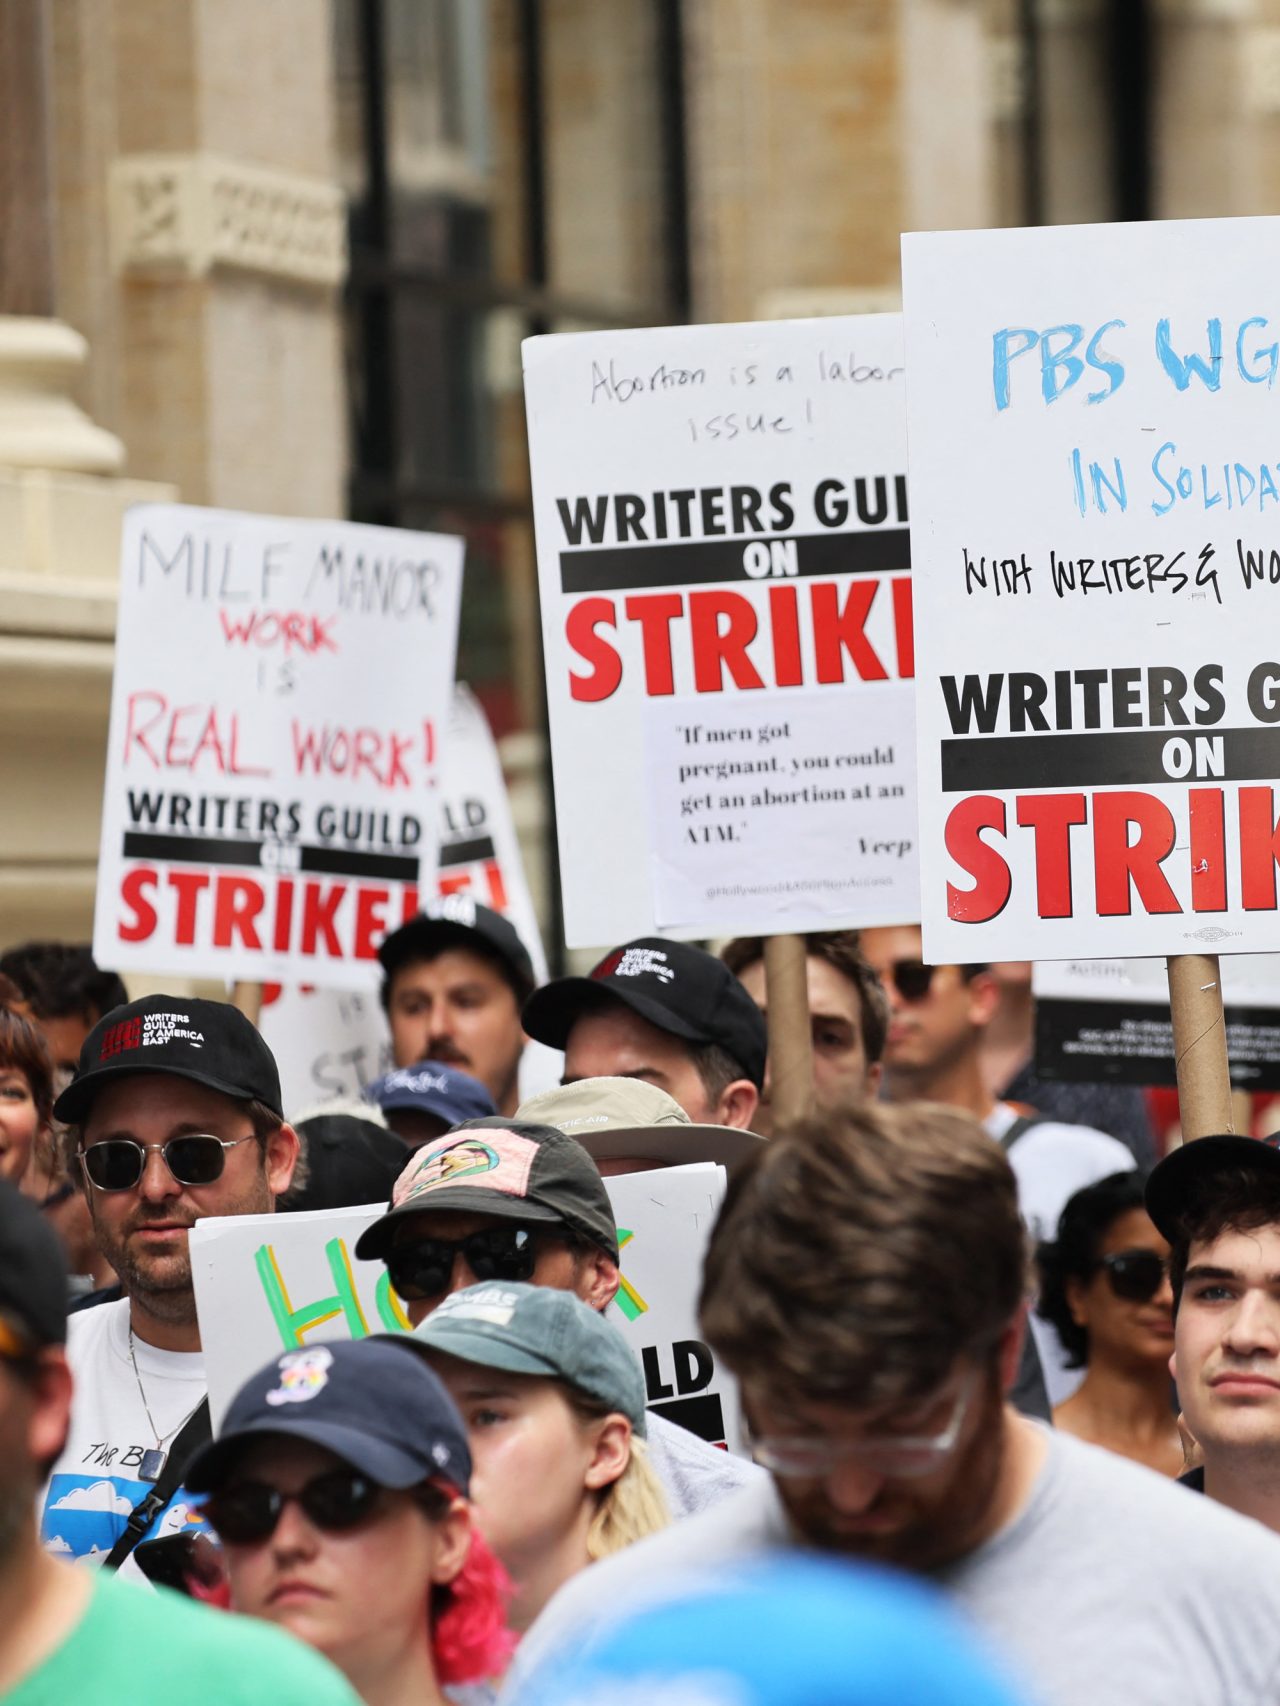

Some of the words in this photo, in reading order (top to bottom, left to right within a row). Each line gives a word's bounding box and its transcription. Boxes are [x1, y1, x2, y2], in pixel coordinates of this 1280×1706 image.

[591, 358, 706, 403] Abortion
[730, 364, 758, 387] is
[776, 366, 793, 384] a
[819, 351, 904, 383] labor
[991, 318, 1126, 413] PBS
[1069, 448, 1128, 518] IN
[556, 482, 796, 546] WRITERS
[813, 474, 909, 528] GUI
[138, 530, 290, 602] MILF
[305, 547, 443, 621] MANOR
[742, 540, 798, 579] ON
[963, 547, 1033, 595] WITH
[219, 609, 338, 654] WORK
[565, 577, 915, 703] STRIK
[940, 664, 1226, 735] WRITERS
[122, 691, 272, 775] REAL
[292, 718, 438, 790] WORK!
[706, 729, 752, 744] men
[758, 723, 791, 744] got
[791, 755, 830, 776] you
[835, 746, 895, 767] could
[1161, 736, 1225, 779] ON
[127, 790, 301, 835] WRITERS
[315, 805, 421, 846] GUILD
[681, 794, 713, 816] get
[719, 795, 745, 810] an
[751, 785, 846, 807] abortion
[851, 783, 871, 800] at
[878, 786, 904, 799] an
[260, 841, 302, 871] ON
[118, 867, 420, 961] STRIKE
[142, 1029, 155, 1039] of
[156, 1028, 205, 1042] AMERICA
[143, 1021, 176, 1031] GUILD
[144, 1013, 190, 1024] WRITERS
[142, 1036, 171, 1047] EAST
[82, 1442, 119, 1467] The
